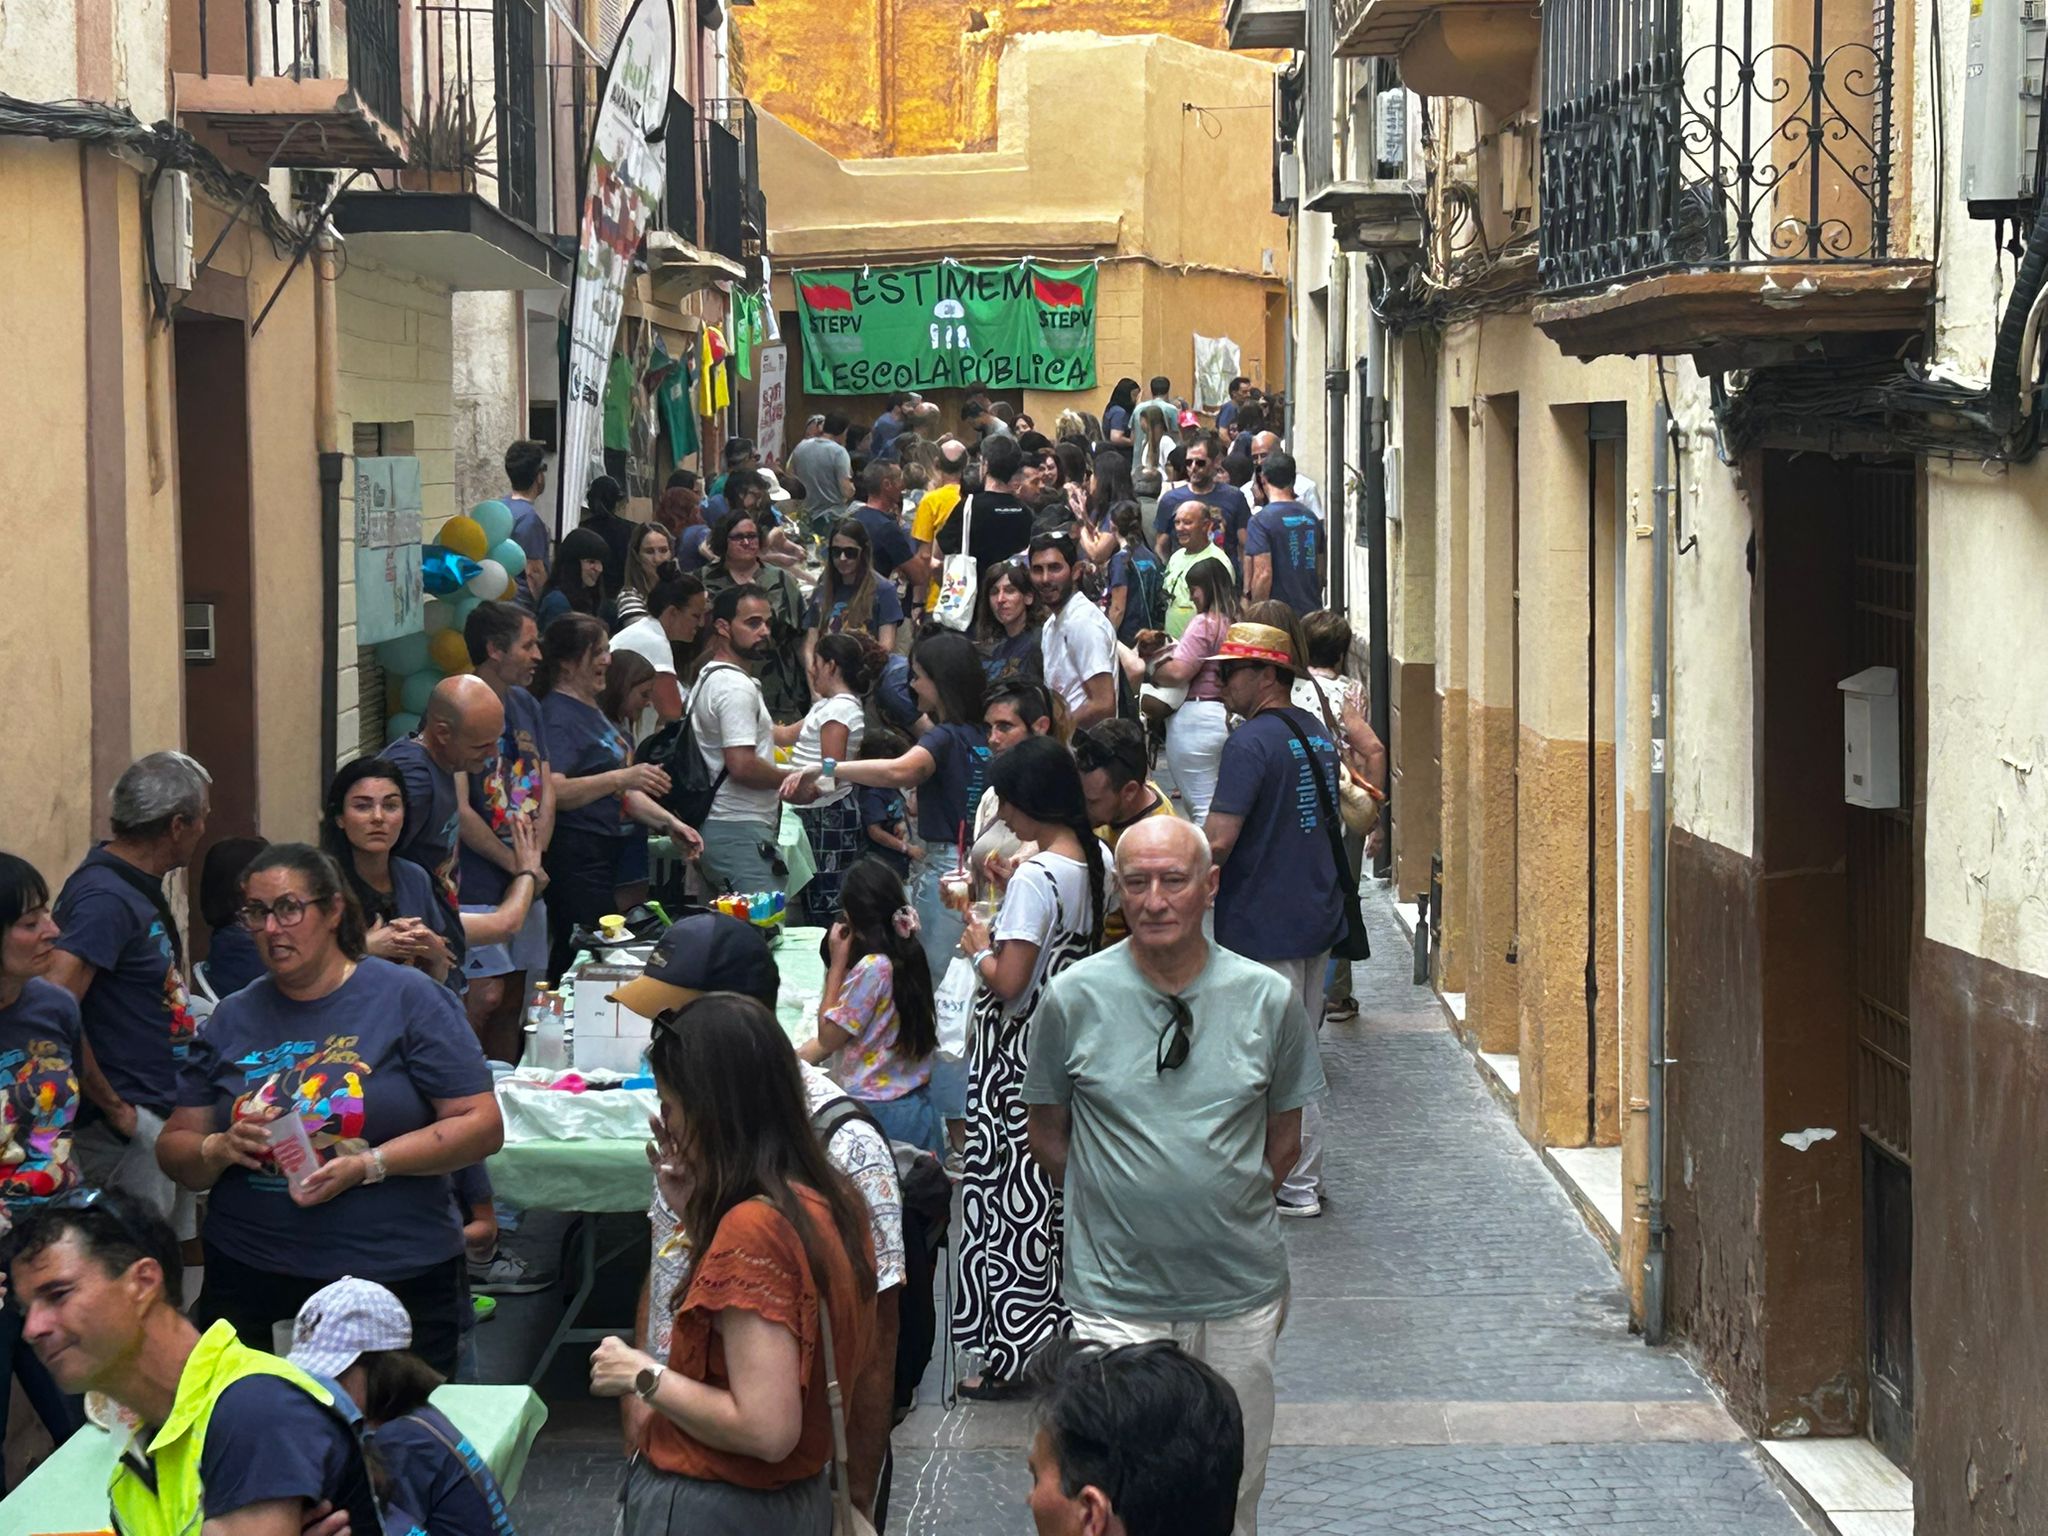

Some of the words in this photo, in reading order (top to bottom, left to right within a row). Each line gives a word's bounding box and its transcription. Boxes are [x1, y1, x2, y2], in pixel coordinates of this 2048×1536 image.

[853, 263, 1032, 305] ESTIMEM
[809, 314, 862, 334] STEPV
[1038, 309, 1092, 328] STEPV
[811, 357, 951, 391] L'ESCOLA
